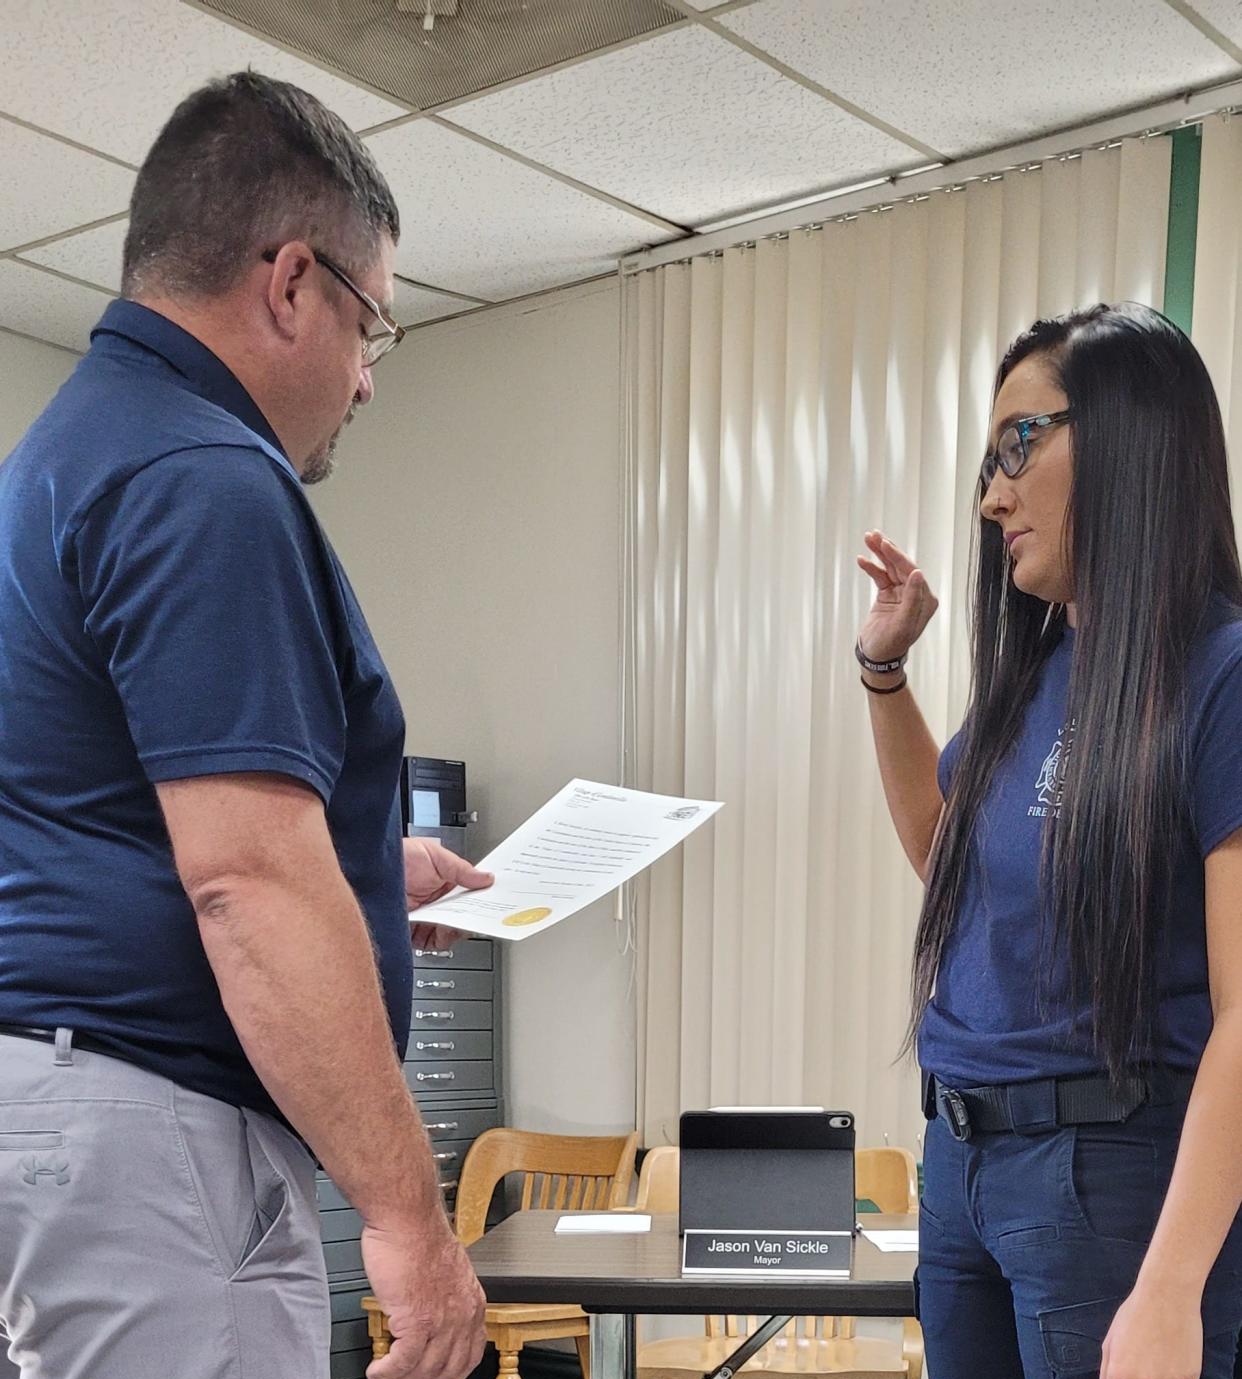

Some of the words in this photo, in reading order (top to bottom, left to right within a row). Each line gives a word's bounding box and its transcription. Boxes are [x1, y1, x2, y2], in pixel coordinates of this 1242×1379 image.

[1027, 806, 1048, 817] FIRE
[707, 1239, 750, 1253] Jason
[754, 1240, 782, 1253] Van
[786, 1241, 829, 1254] Sickle
[754, 1256, 781, 1266] Mayor
